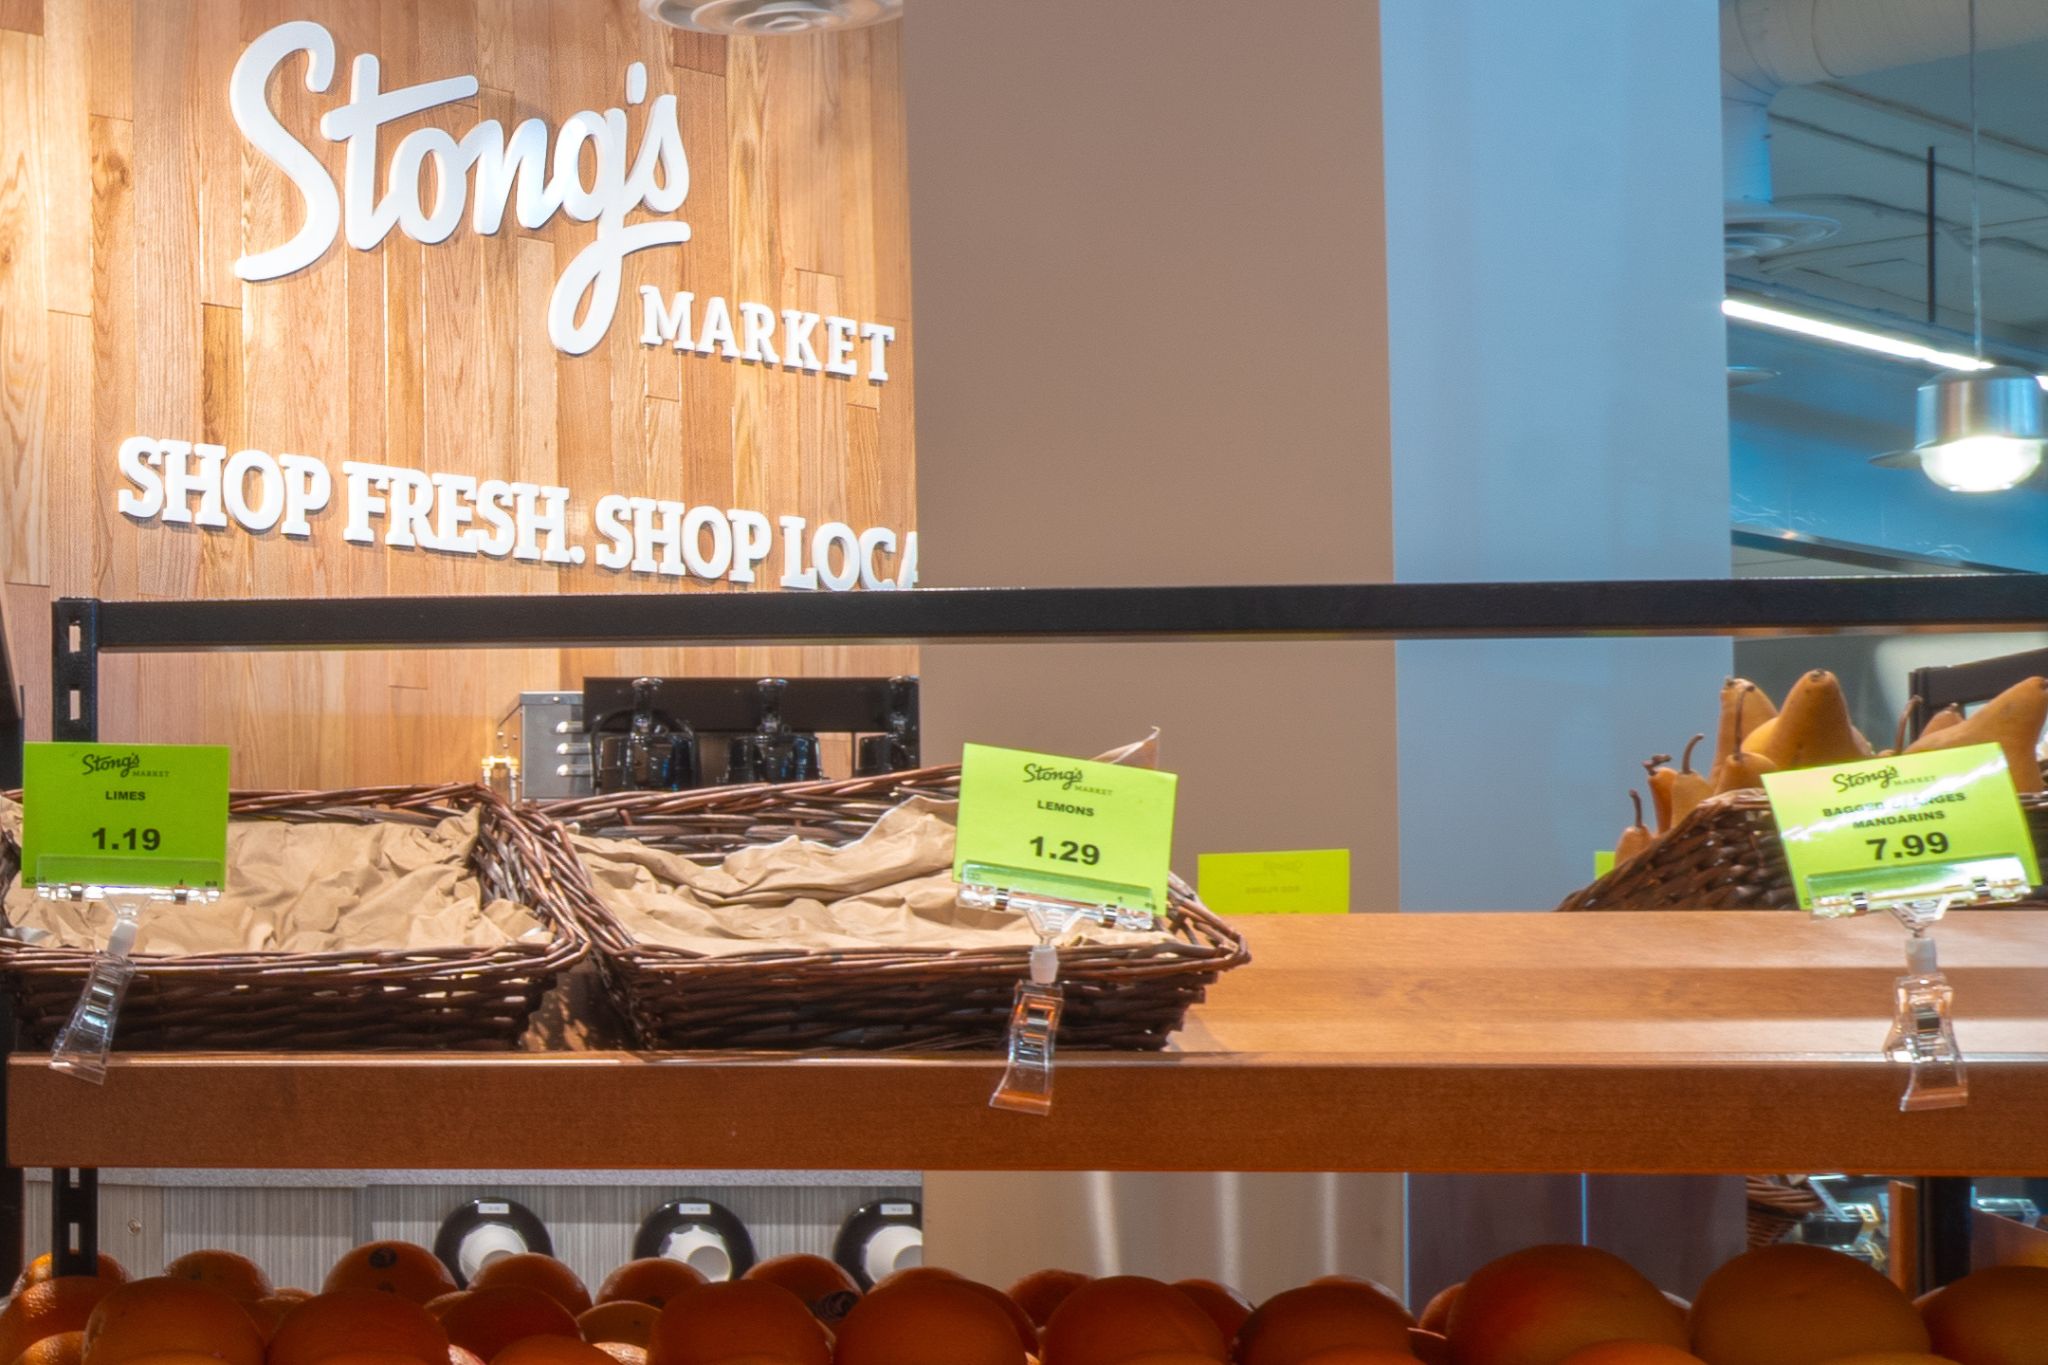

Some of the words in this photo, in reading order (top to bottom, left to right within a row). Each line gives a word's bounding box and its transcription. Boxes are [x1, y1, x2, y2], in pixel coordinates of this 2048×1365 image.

[229, 20, 691, 355] Stong's
[640, 284, 896, 383] MARKET
[118, 436, 330, 535] SHOP
[342, 461, 586, 564] FRESH.
[594, 494, 772, 583] SHOP
[82, 752, 141, 778] Stong's
[132, 770, 170, 778] MARKET
[1023, 763, 1083, 790] Stong's
[1074, 784, 1113, 796] MARKET
[1832, 765, 1899, 793] Stong's
[105, 791, 146, 801] LIMES
[1037, 800, 1095, 817] LEMONS
[1852, 810, 1946, 828] MANDARINS
[92, 828, 161, 851] 1.19
[1029, 836, 1101, 866] 1.29
[1866, 831, 1949, 861] 7.99
